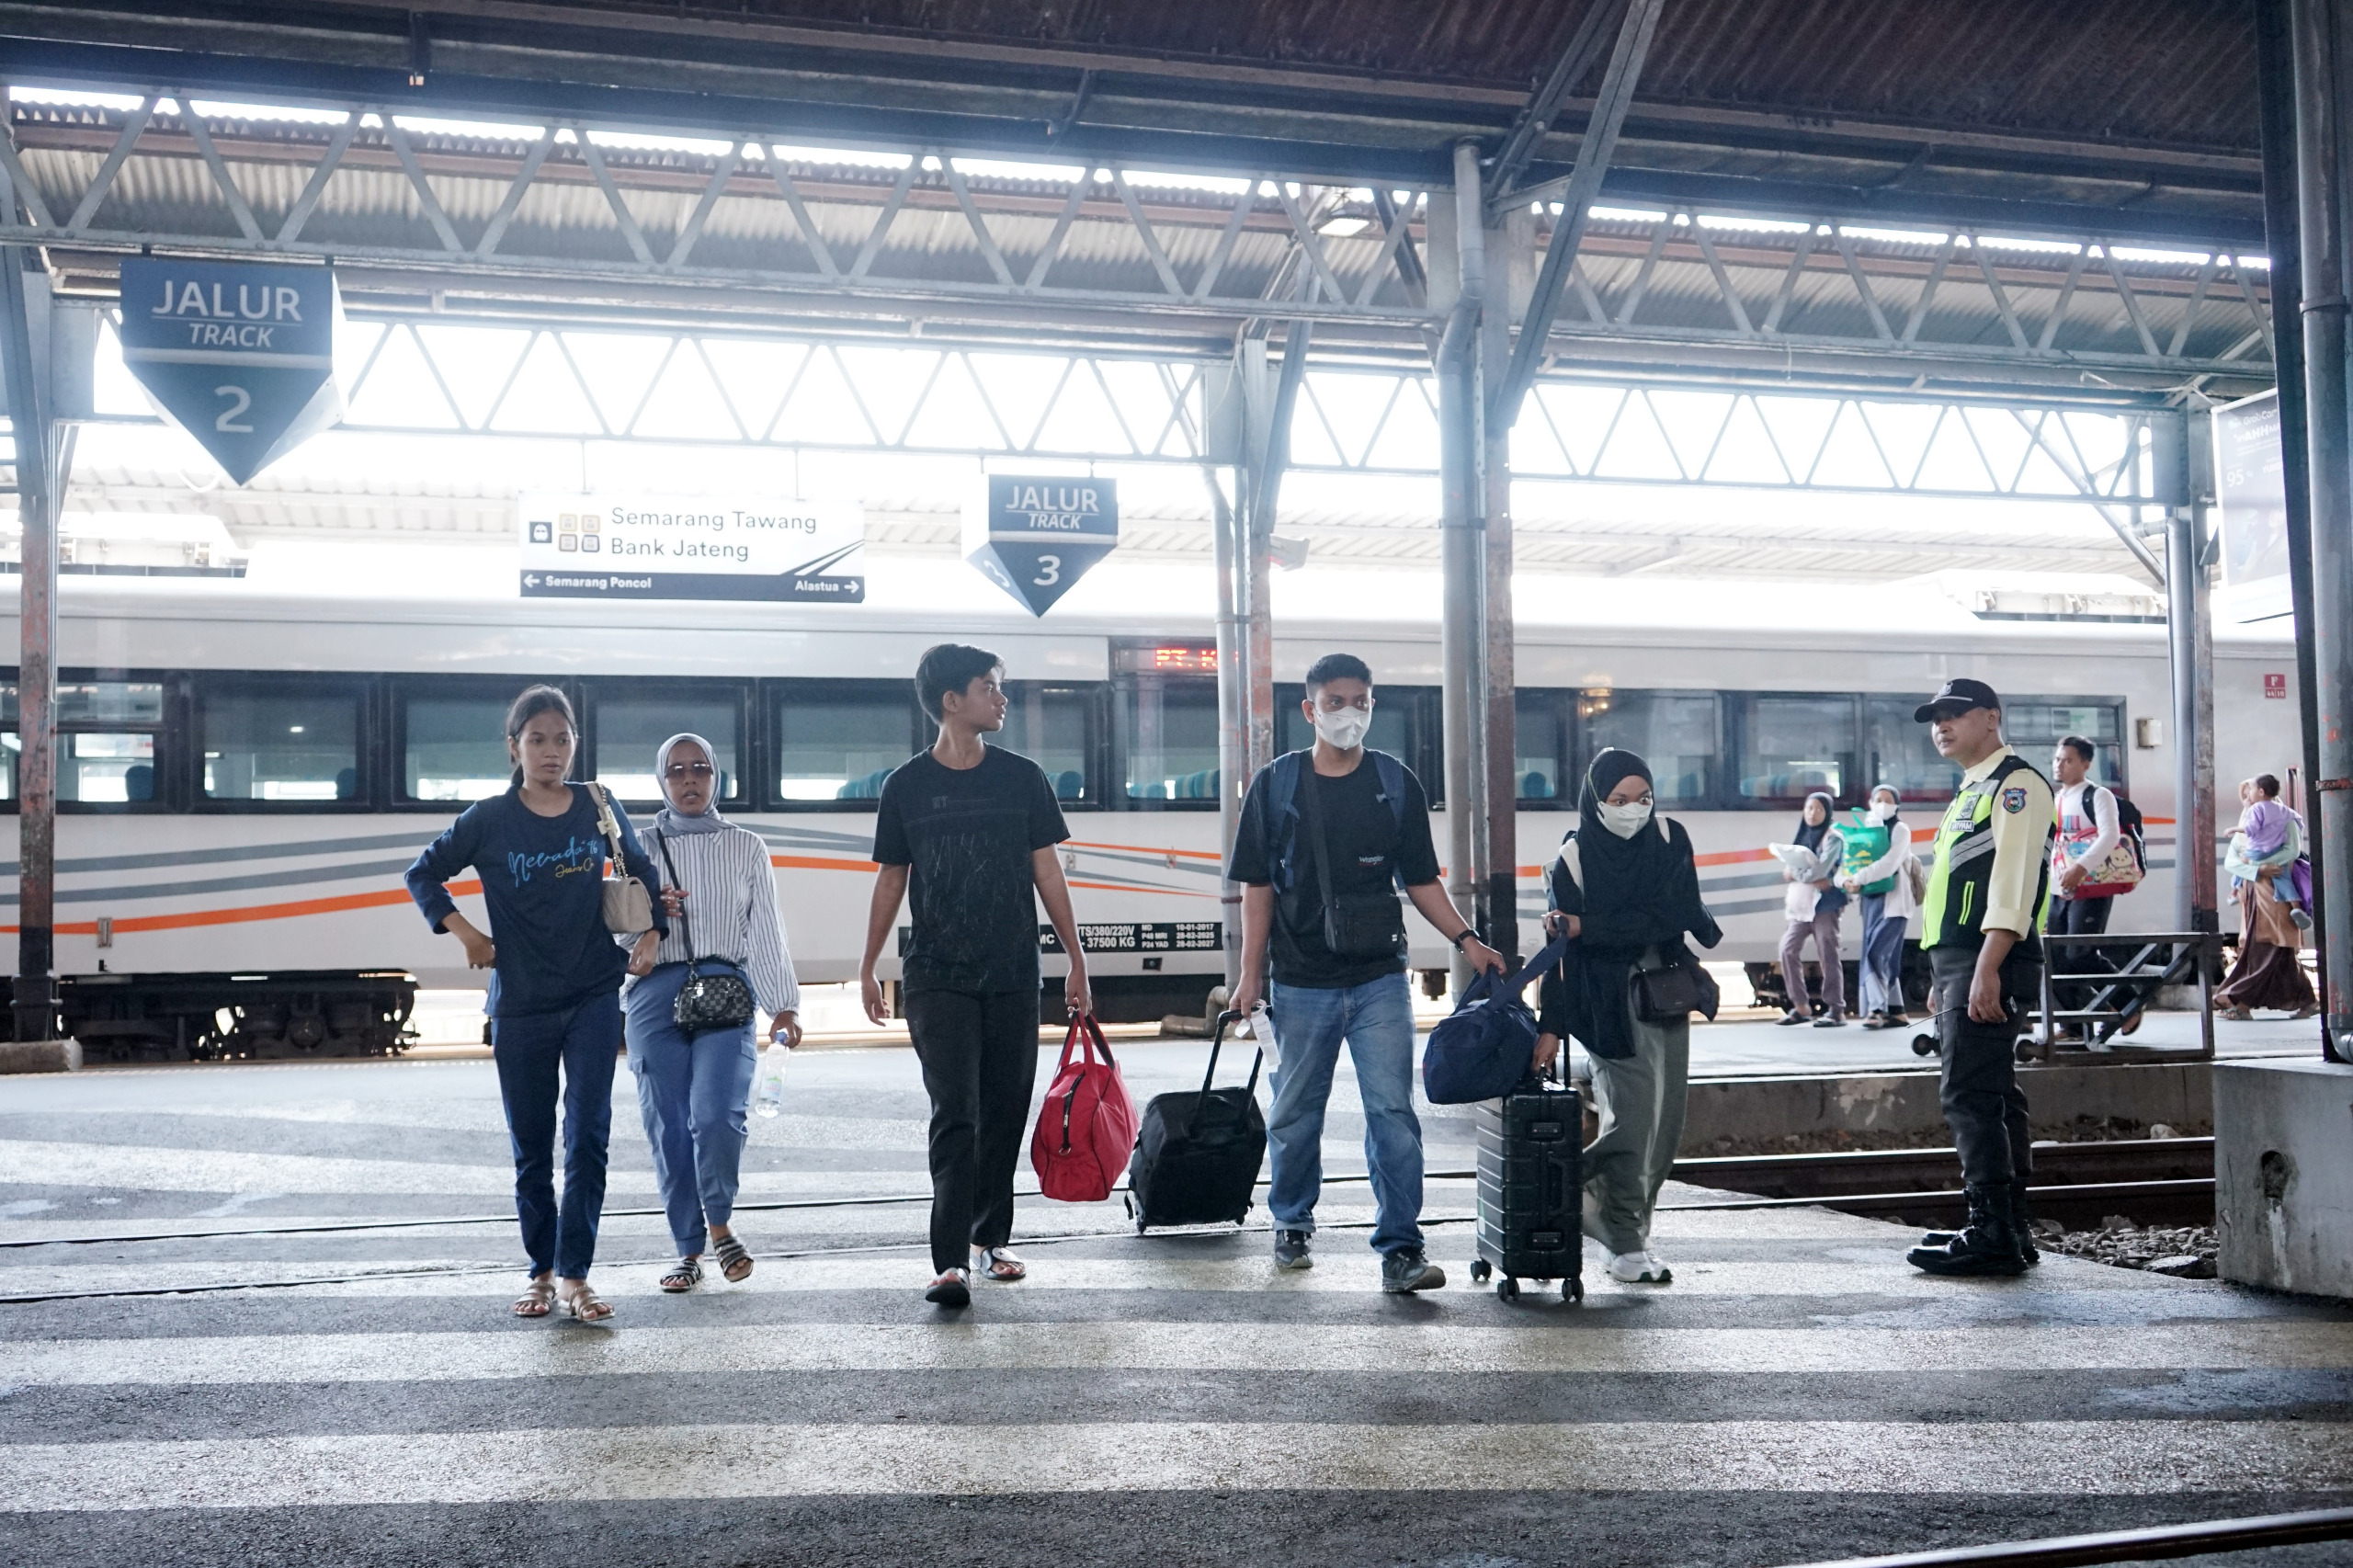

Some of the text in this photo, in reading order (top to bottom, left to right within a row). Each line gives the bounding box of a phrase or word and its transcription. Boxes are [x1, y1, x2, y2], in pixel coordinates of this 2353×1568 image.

[151, 280, 302, 322] JALUR
[189, 324, 274, 347] TRACK
[214, 385, 254, 433] 2
[1005, 485, 1100, 513] JALUR
[610, 506, 724, 531] Semarang
[733, 510, 817, 535] Tawang
[1028, 513, 1082, 529] TRACK
[610, 538, 665, 556] Bank
[672, 539, 750, 562] Jateng
[545, 574, 652, 590] Semarang Poncol
[1033, 554, 1062, 586] 3
[794, 579, 840, 593] Alastua
[508, 836, 585, 888] Nevada
[1358, 856, 1384, 865] Wrangler
[1086, 937, 1117, 949] 37500
[1119, 937, 1136, 948] KG
